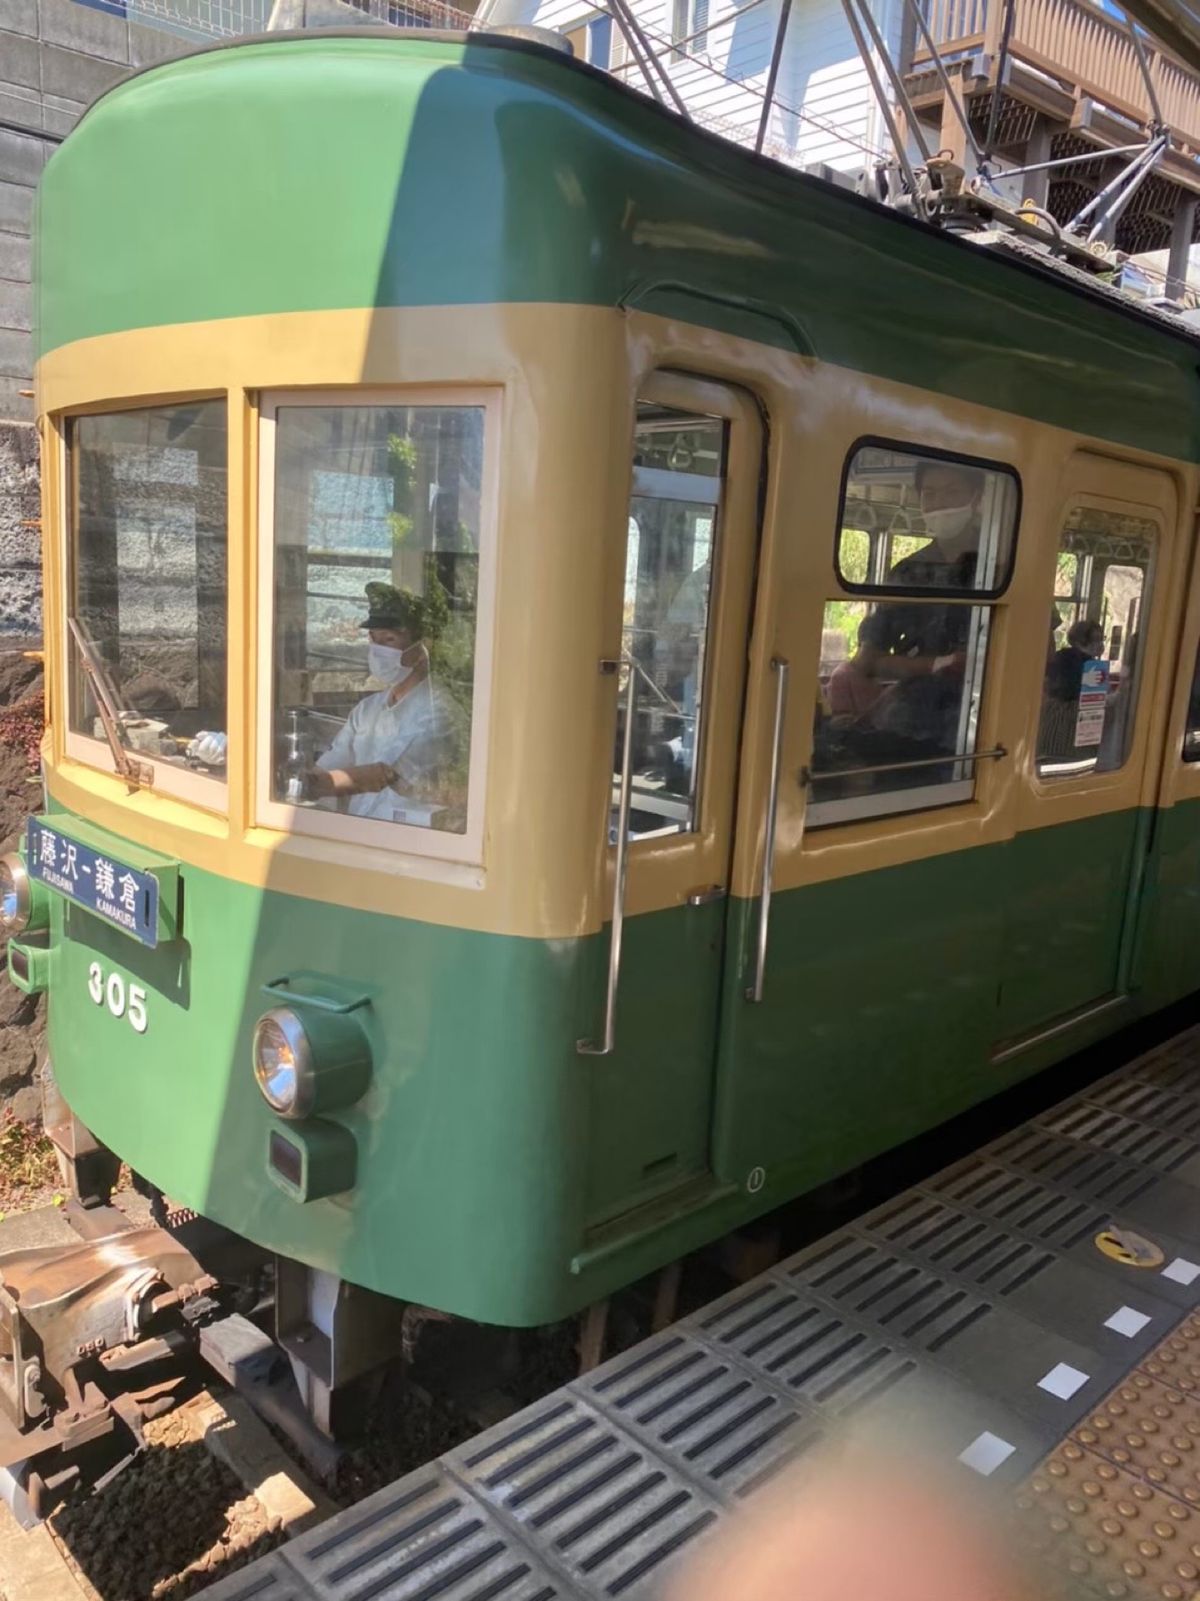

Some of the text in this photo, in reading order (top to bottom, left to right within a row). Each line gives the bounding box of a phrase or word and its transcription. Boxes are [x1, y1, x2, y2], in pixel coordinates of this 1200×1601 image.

[42, 867, 75, 894] FUJISAWA
[95, 897, 137, 930] KAMAKURA
[88, 961, 147, 1033] 305
